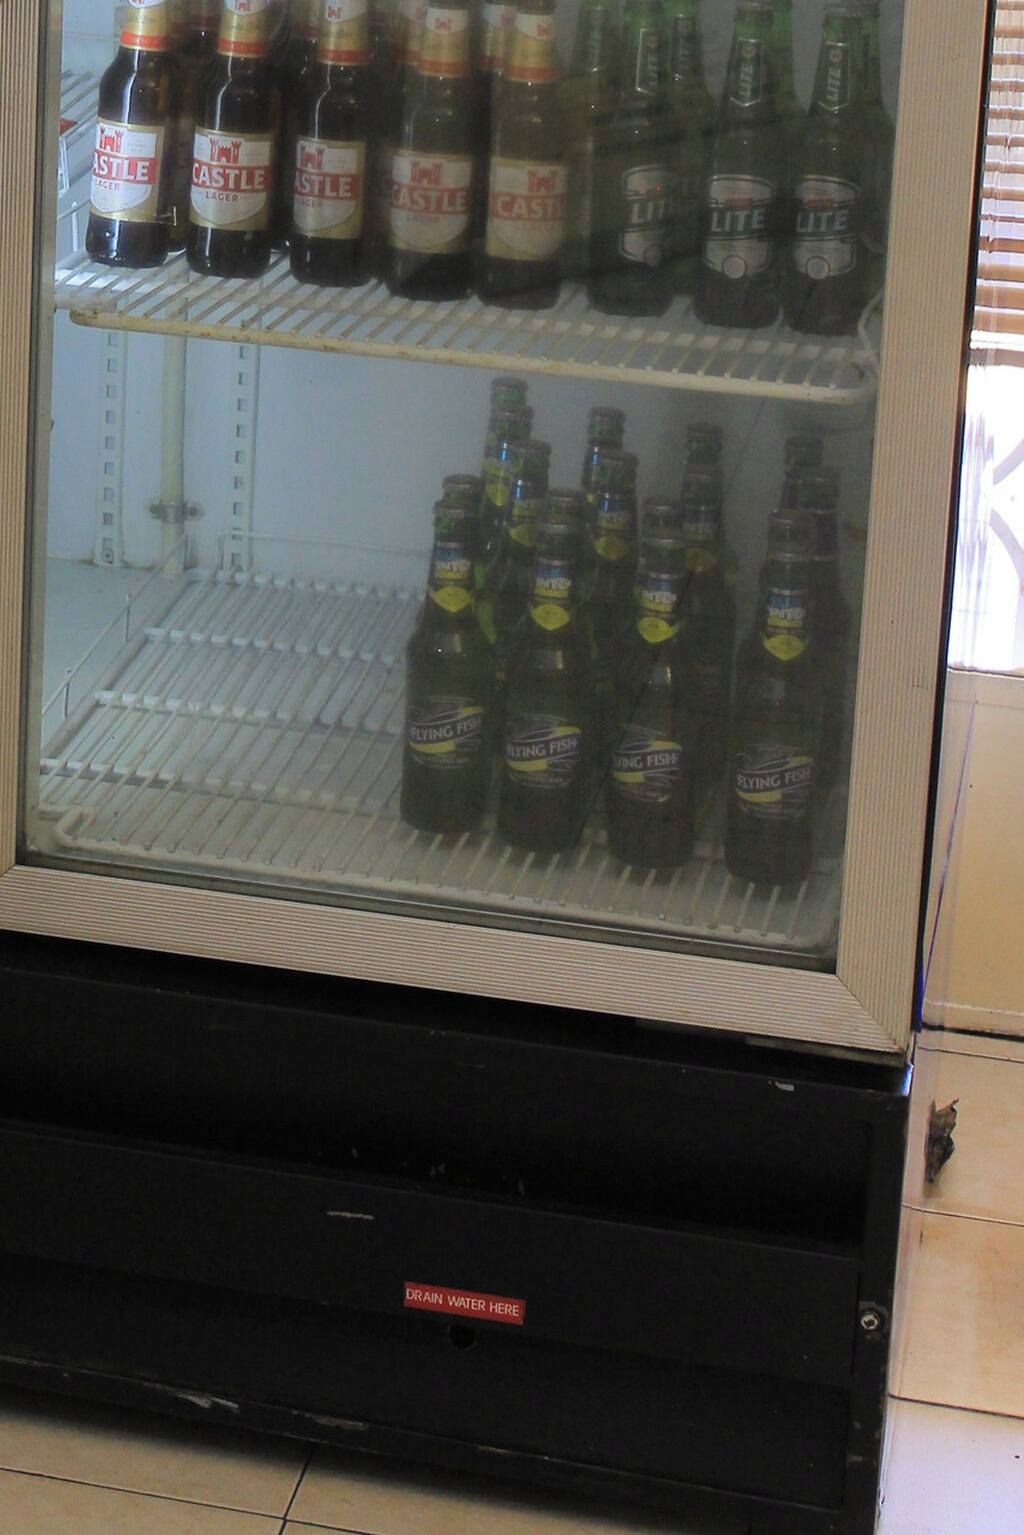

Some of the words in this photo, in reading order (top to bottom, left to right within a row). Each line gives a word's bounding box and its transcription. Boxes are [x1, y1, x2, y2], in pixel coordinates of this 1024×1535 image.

[738, 64, 754, 98] LITE
[827, 65, 842, 102] LITE
[92, 153, 150, 181] ASTLE
[192, 163, 265, 190] CASTLE
[205, 192, 239, 202] LAGER
[294, 175, 352, 198] ASTLE
[496, 195, 562, 219] CAST
[631, 201, 666, 225] LIT
[711, 209, 766, 232] LITE
[796, 209, 850, 233] LITE
[410, 726, 454, 742] FLYING
[549, 738, 577, 755] FISH
[647, 753, 679, 767] FISH
[737, 774, 782, 790] FLYING
[784, 768, 811, 784] FISH
[406, 1288, 443, 1305] DRAIN
[447, 1295, 486, 1311] WATER
[489, 1301, 520, 1317] HERE
